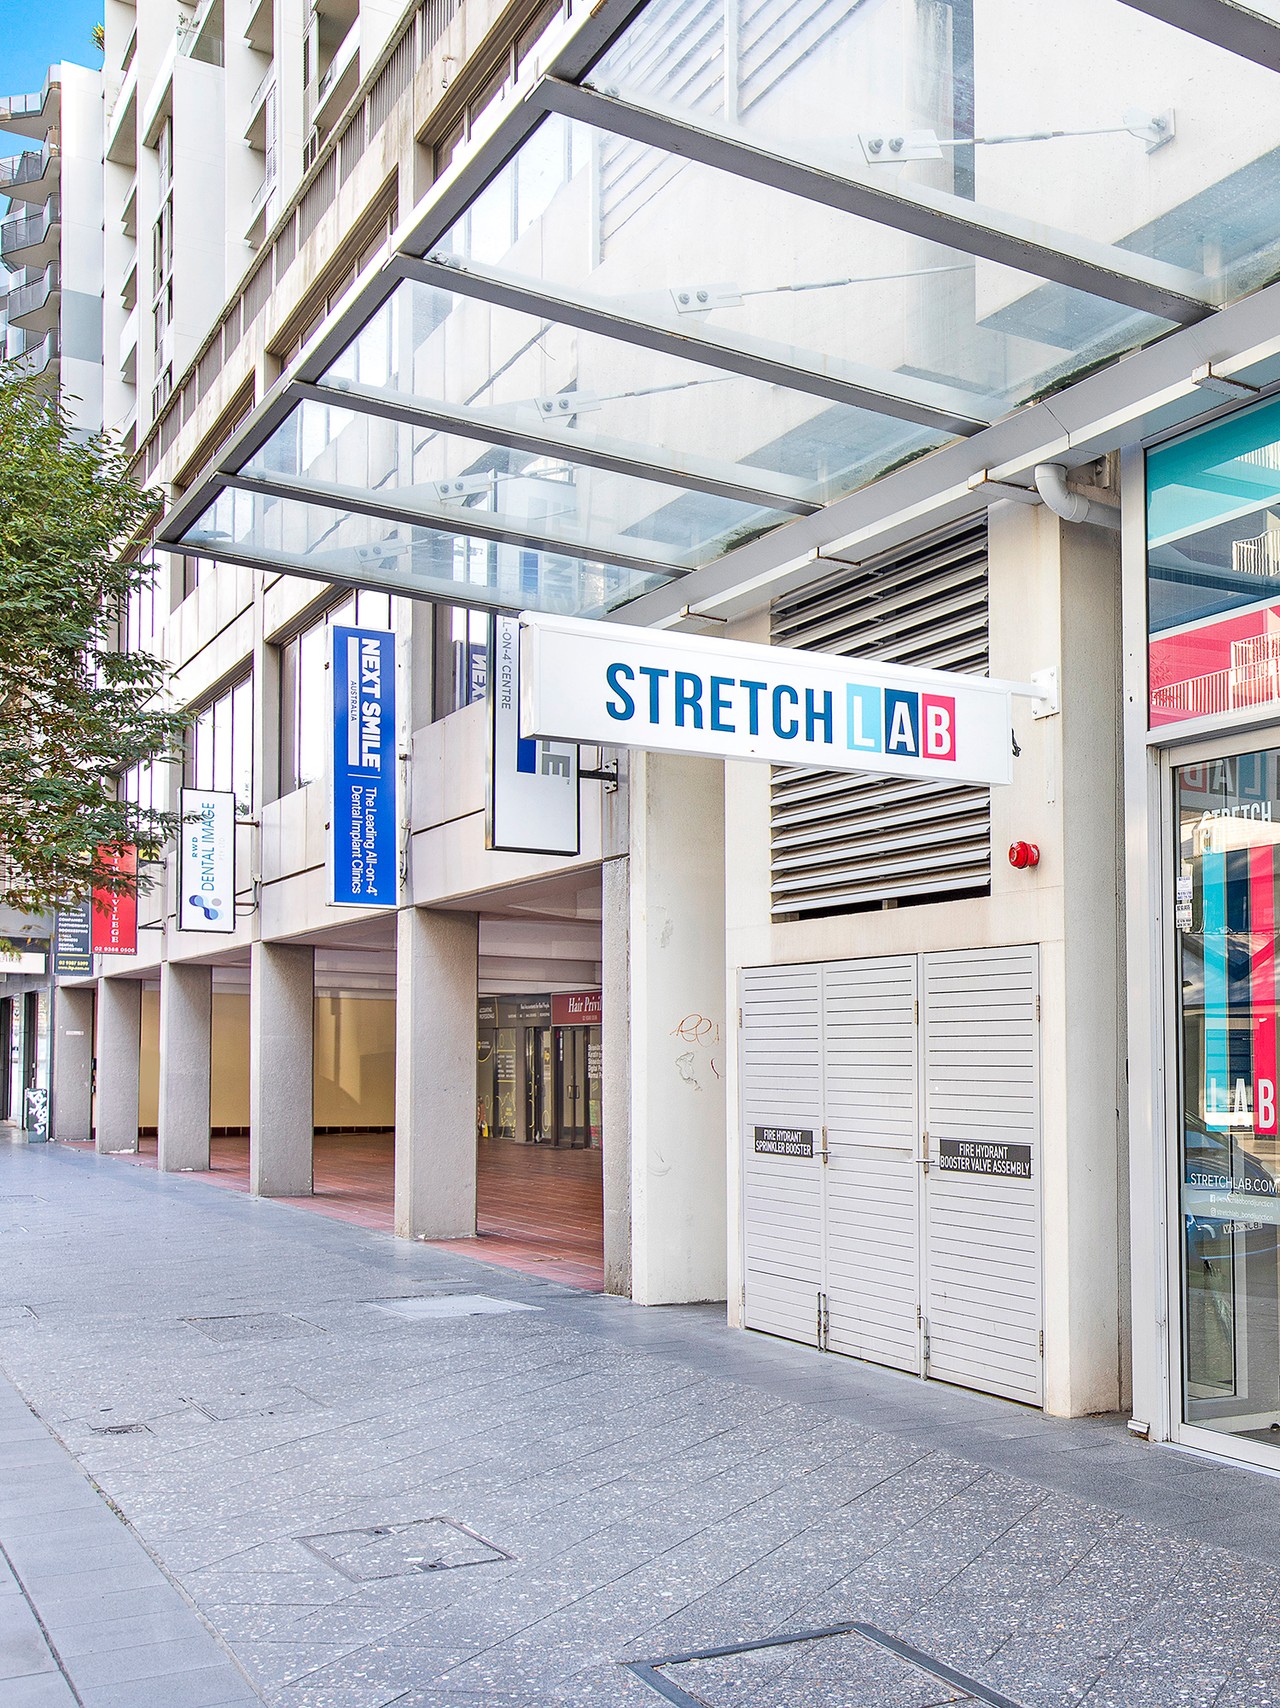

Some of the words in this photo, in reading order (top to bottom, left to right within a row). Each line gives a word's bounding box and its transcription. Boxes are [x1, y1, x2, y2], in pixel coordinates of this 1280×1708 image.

[362, 638, 381, 699] NEXT
[502, 665, 512, 710] CENTRE
[350, 681, 358, 722] AUSTRALIA
[605, 662, 833, 744] STRETCH
[853, 694, 952, 756] LAB
[362, 701, 382, 768] SMILE
[351, 785, 363, 818] Dental
[366, 787, 377, 807] The
[201, 803, 215, 843] IMAGE
[350, 820, 363, 858] Implant
[363, 809, 377, 849] Leading
[201, 847, 215, 891] DENTAL
[351, 859, 363, 894] Clinics
[568, 997, 584, 1013] Hair
[1211, 1078, 1275, 1129] LAB
[755, 1140, 785, 1153] SPRINKLER
[785, 1143, 812, 1156] BOOSTER
[763, 1129, 776, 1141] FIRE
[776, 1130, 802, 1142] HYDRANT
[959, 1143, 975, 1157] FIRE
[976, 1145, 1008, 1160] HYDRANT
[940, 1155, 970, 1171] BOOSTER
[970, 1158, 992, 1173] VALVE
[993, 1160, 1030, 1176] ASSEMBLY
